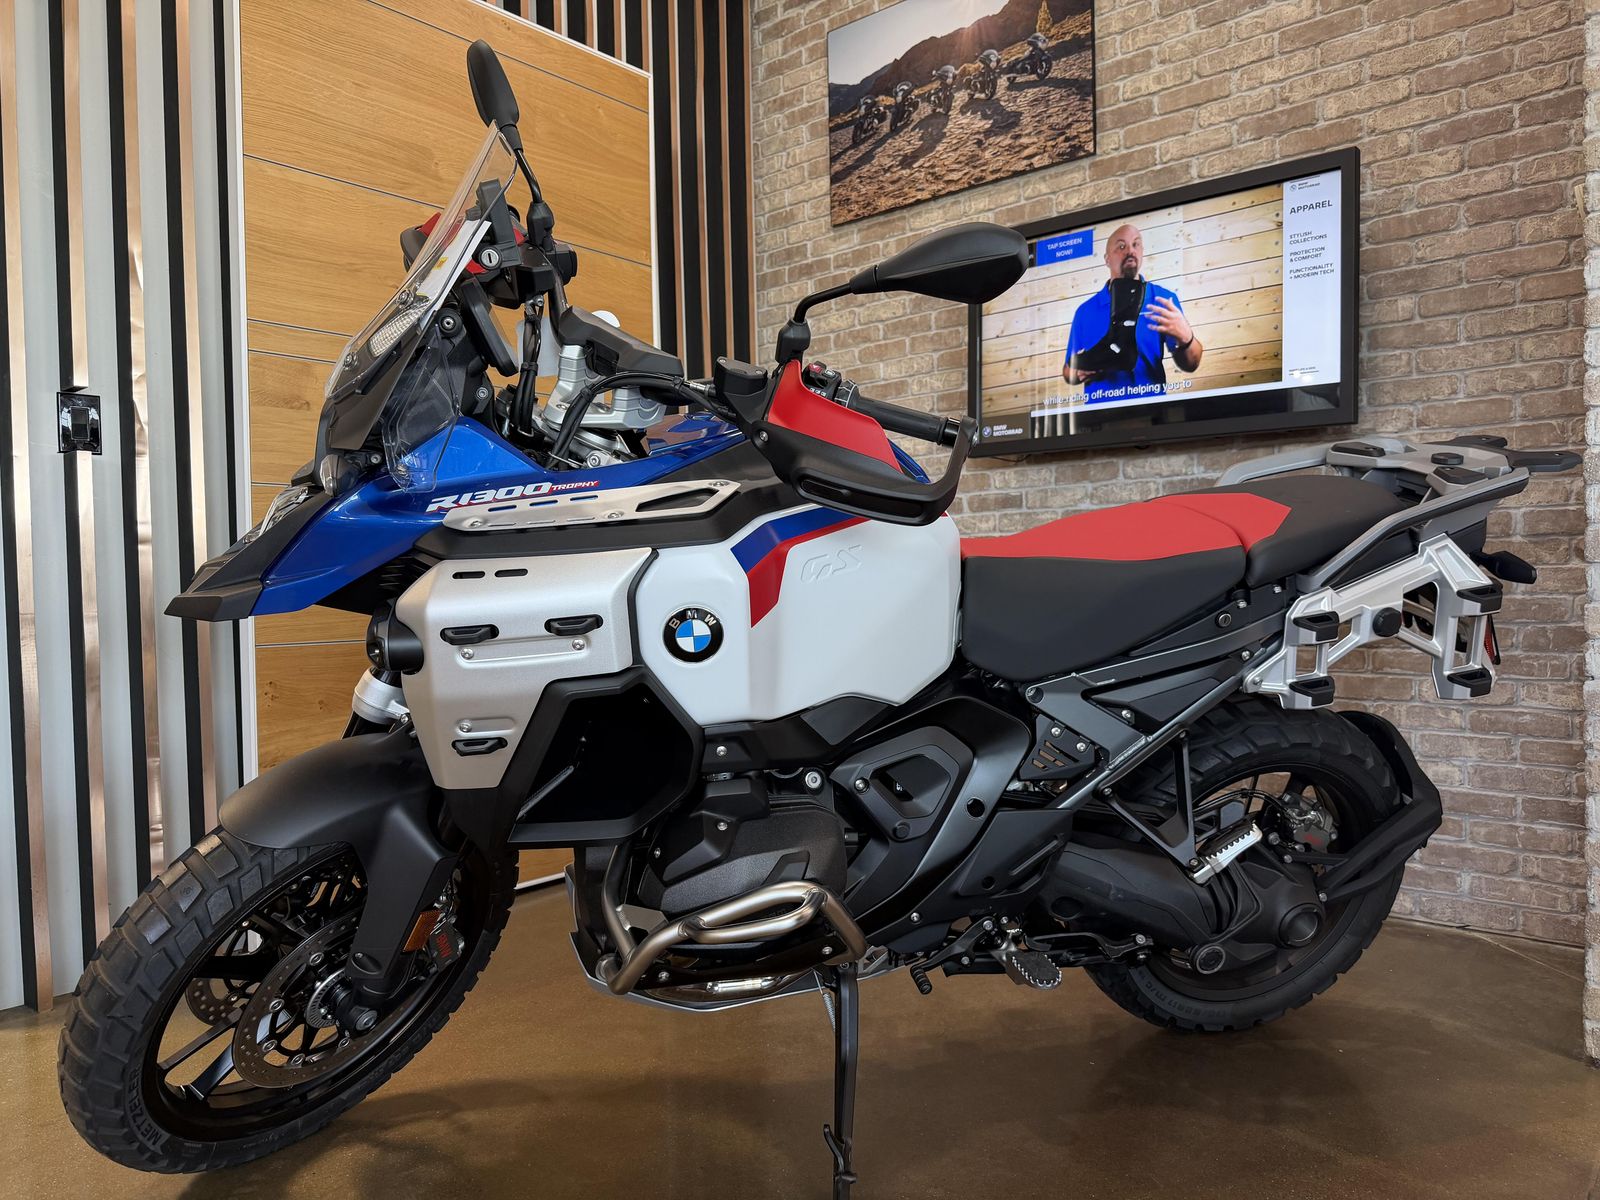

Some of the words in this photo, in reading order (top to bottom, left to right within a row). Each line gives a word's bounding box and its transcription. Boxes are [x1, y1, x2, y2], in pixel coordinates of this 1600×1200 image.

[1289, 199, 1333, 215] APPAREL
[1289, 231, 1312, 239] STYLISH
[1289, 234, 1328, 245] COLLECTIONS
[1059, 238, 1083, 248] SCREEN
[1055, 249, 1073, 258] NOW!
[1289, 246, 1326, 257] PROTECTION
[1294, 253, 1322, 262] COMFORT
[1289, 262, 1334, 275] FUNCTIONALITY
[1294, 271, 1319, 280] MODERN
[1320, 269, 1335, 277] TECH
[1091, 386, 1125, 400] off-road
[1127, 383, 1161, 396] helping
[1162, 382, 1180, 393] you
[1182, 379, 1193, 389] to
[993, 427, 1024, 437] MOTORRAD
[550, 479, 600, 492] TROPHY
[800, 544, 864, 584] GS
[668, 608, 718, 630] BMW
[127, 1064, 162, 1147] METZELER
